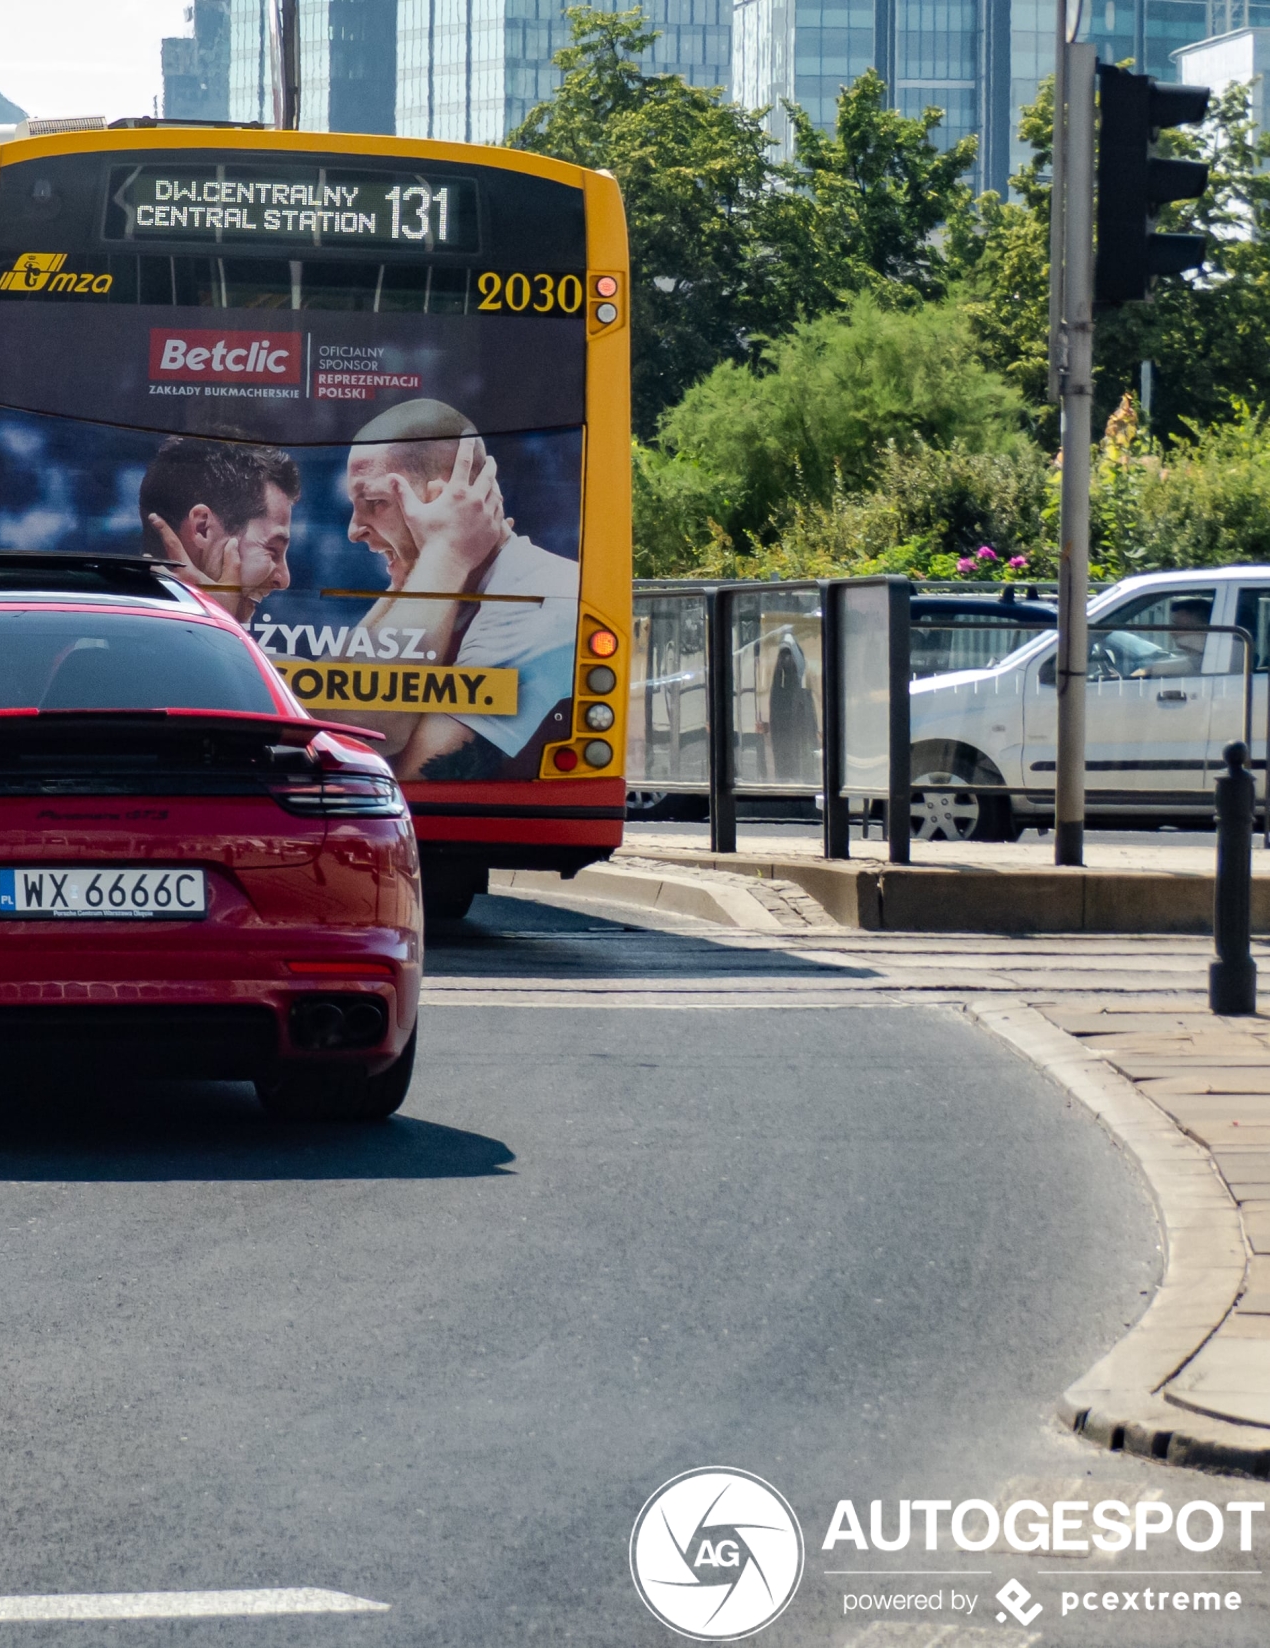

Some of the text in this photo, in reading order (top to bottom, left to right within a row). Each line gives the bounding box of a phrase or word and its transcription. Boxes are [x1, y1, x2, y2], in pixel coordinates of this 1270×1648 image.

[136, 205, 376, 233] CENTRAL STATION
[385, 185, 448, 240] 131
[47, 272, 113, 293] mza
[477, 272, 583, 313] 2030
[160, 339, 290, 374] Betclic
[318, 345, 385, 358] OFICJALNY
[318, 359, 379, 371] SPONSOR
[318, 374, 419, 388] REPREZENTACJI
[149, 385, 300, 399] ZAKŁADY BUKMACHERSKIE
[318, 387, 366, 399] POLSKI
[244, 613, 437, 661] ŻYWASZ.
[1, 895, 14, 905] PL
[23, 873, 196, 908] WX 6666C
